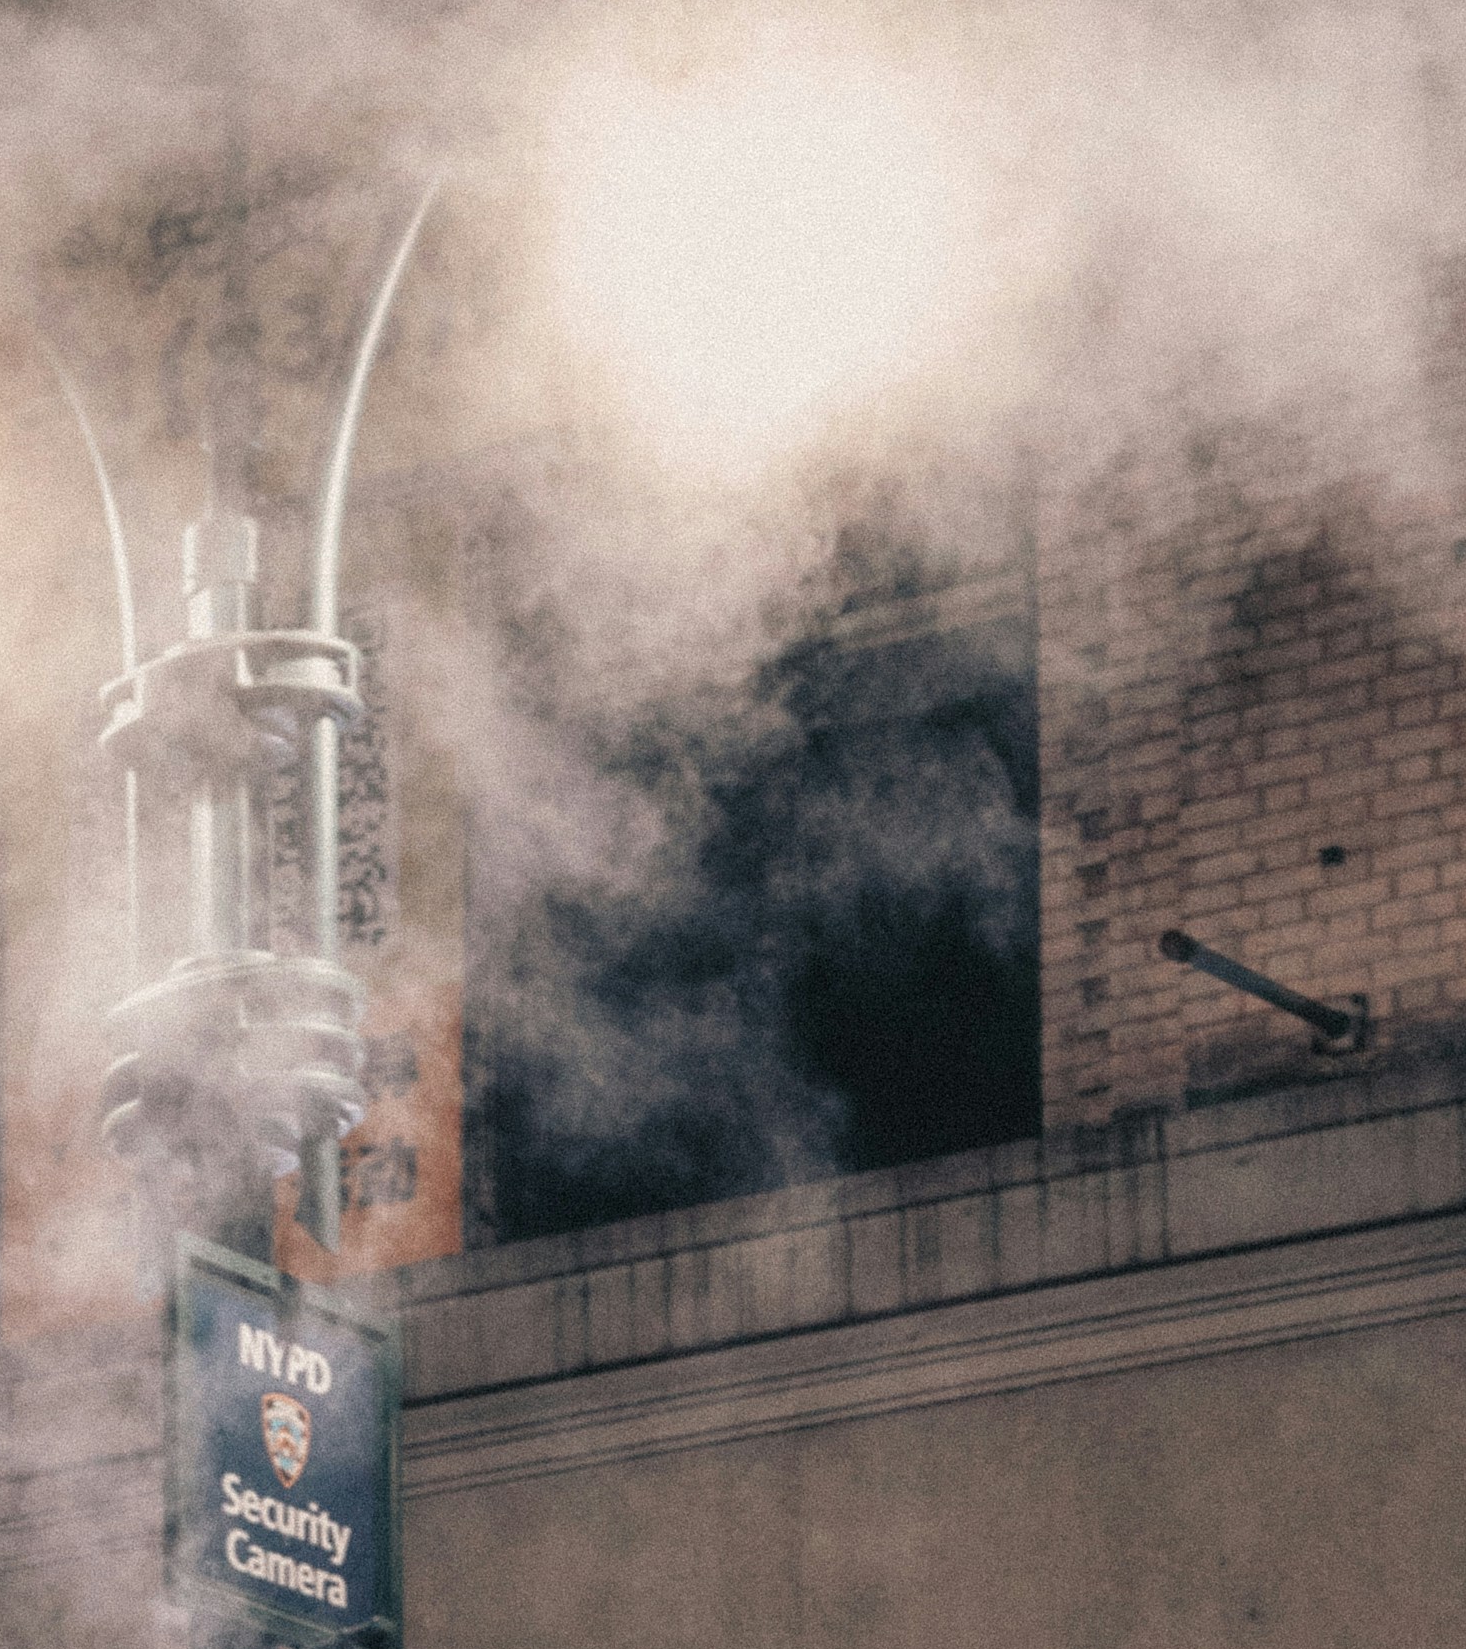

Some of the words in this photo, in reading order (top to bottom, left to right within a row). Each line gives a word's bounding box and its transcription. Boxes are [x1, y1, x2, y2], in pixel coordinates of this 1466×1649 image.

[237, 1321, 333, 1395] NYPD
[220, 1472, 352, 1566] Security
[224, 1527, 349, 1609] Camera
